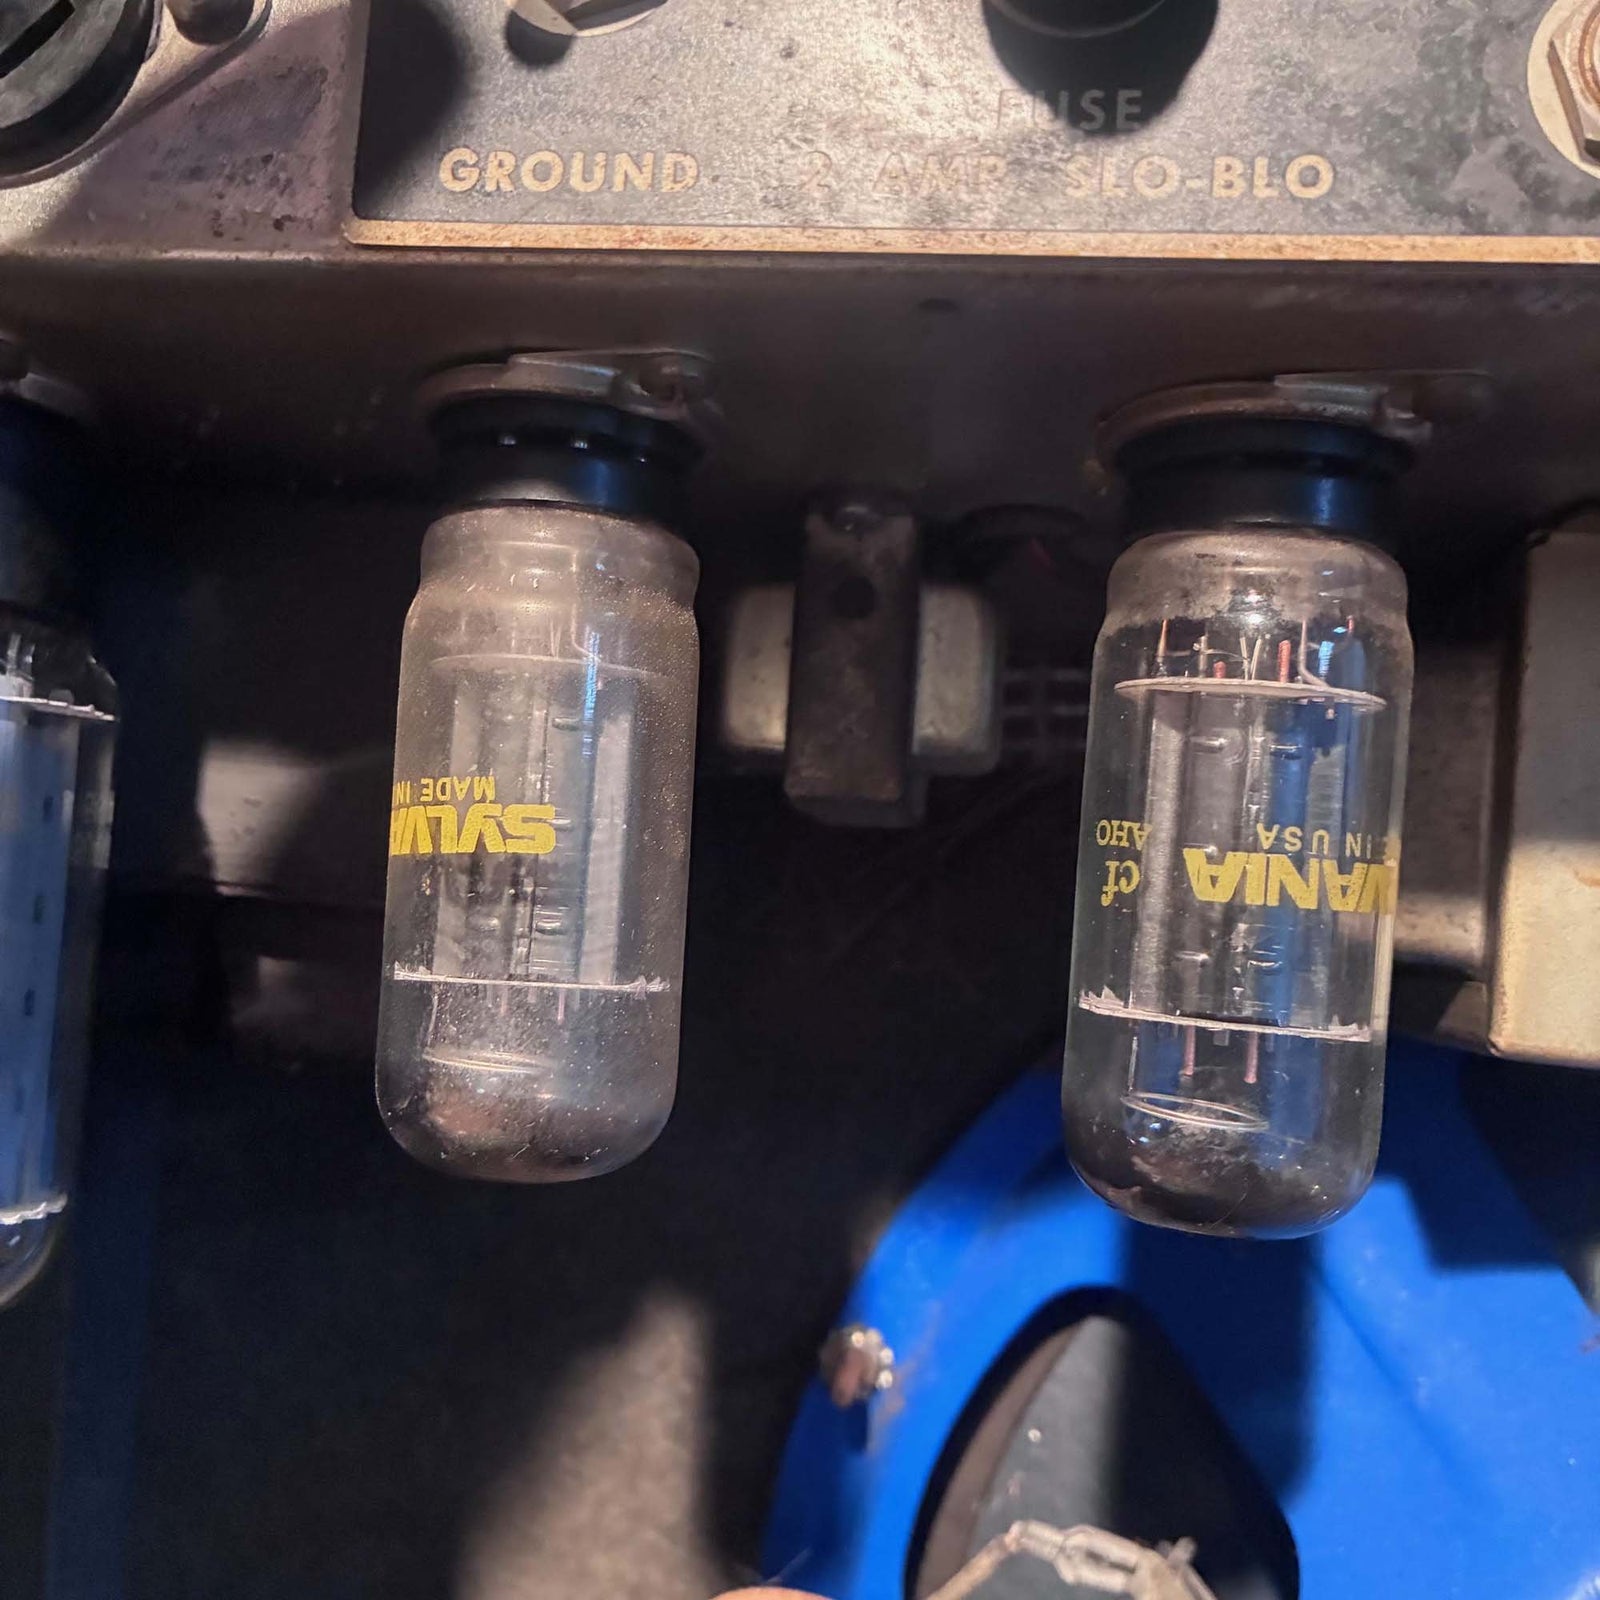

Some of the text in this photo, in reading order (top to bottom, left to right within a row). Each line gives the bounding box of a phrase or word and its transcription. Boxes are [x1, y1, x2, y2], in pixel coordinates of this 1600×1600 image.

[997, 88, 1144, 132] FUSE
[438, 147, 700, 194] GROUND
[1064, 153, 1336, 200] SLO-BLO
[420, 775, 497, 802] MADE
